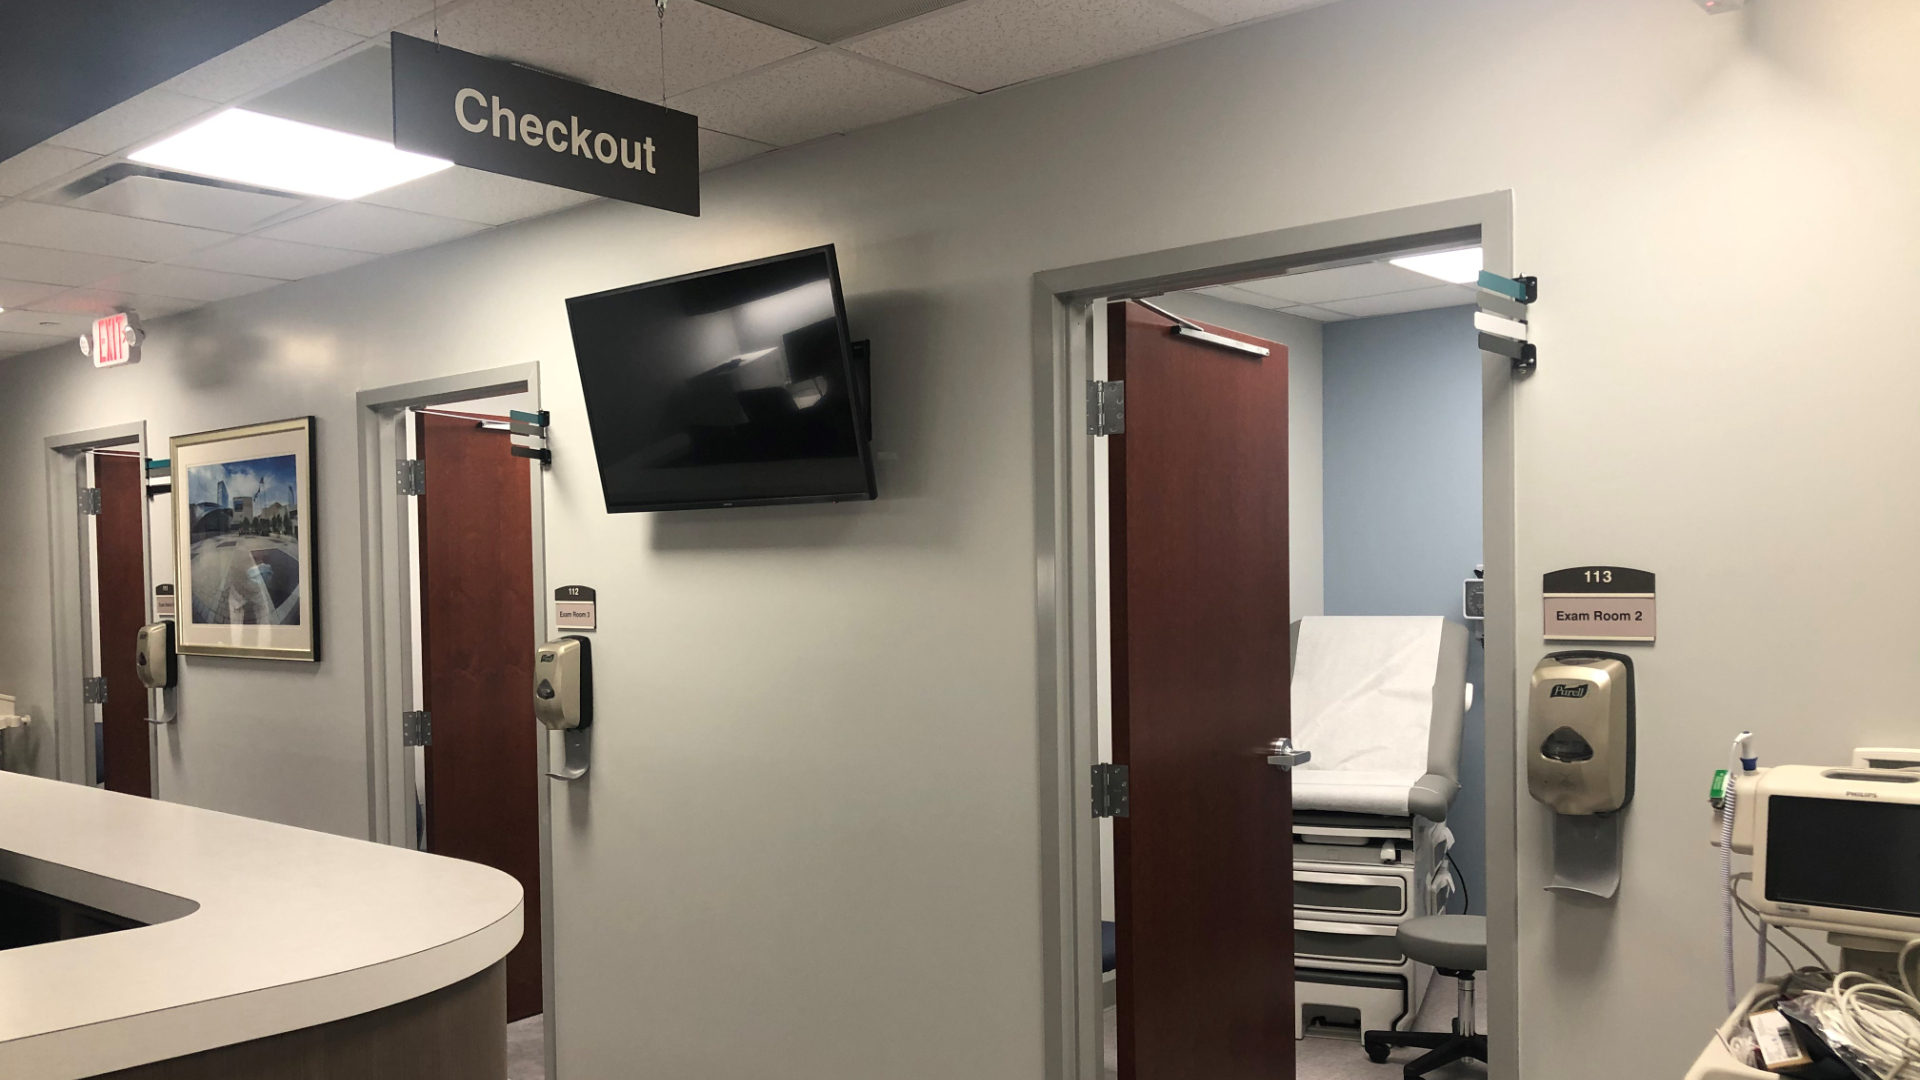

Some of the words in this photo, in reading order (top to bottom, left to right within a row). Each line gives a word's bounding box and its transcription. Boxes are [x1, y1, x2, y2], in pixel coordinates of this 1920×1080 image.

[454, 87, 657, 175] Checkout
[98, 315, 123, 363] EXIT
[1584, 570, 1613, 583] 113
[568, 587, 579, 596] 112
[1556, 610, 1590, 621] Exam
[1593, 610, 1631, 621] Room
[1634, 610, 1643, 621] 2
[1553, 685, 1585, 697] Purell
